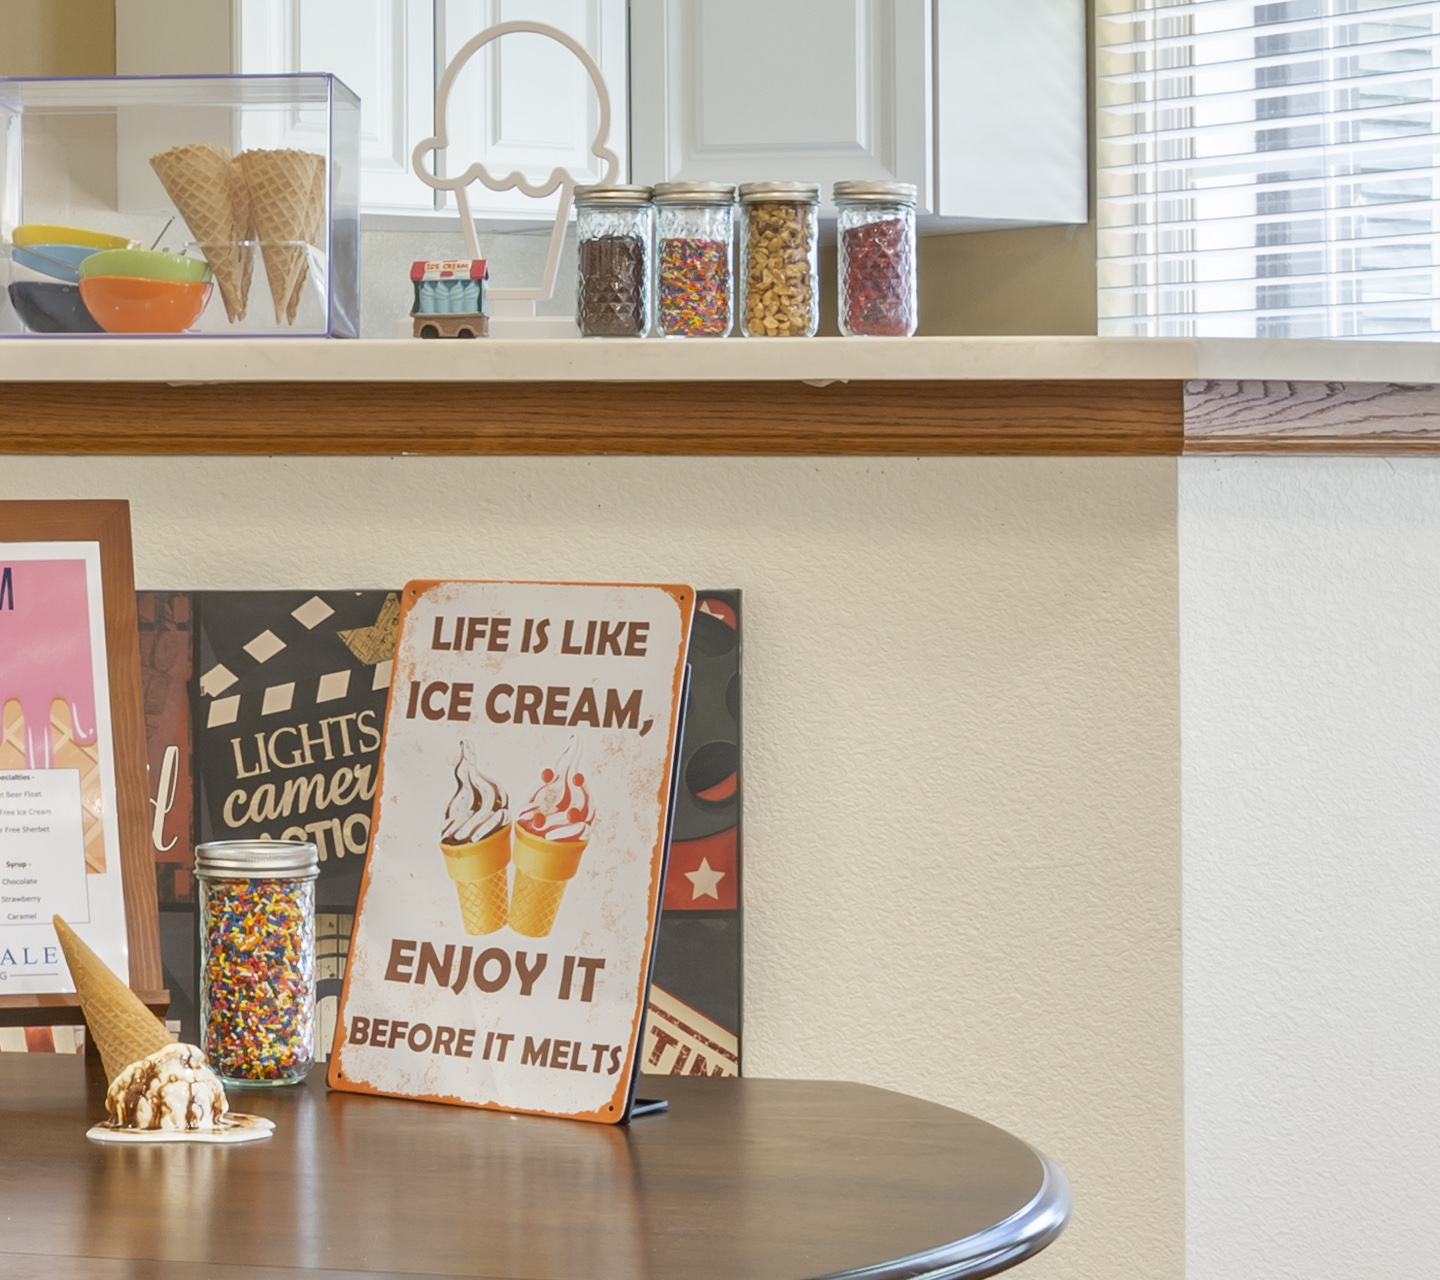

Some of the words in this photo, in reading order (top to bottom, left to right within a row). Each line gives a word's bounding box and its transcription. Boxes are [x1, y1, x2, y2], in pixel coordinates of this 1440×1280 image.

[432, 616, 511, 652] LIFE
[520, 618, 550, 654] IS
[561, 620, 650, 657] LIKE
[406, 681, 474, 721] ICE
[485, 683, 653, 737] CREAM,
[230, 709, 381, 780] LIGHTS
[6, 790, 22, 798] Beer
[24, 790, 42, 798] Float
[223, 763, 379, 828] camer
[0, 808, 15, 816] Free
[29, 807, 52, 815] Cream
[6, 860, 27, 869] Syrup
[2, 877, 37, 885] Chocolate
[1, 895, 41, 903] Strawberry
[7, 912, 37, 920] Caramel
[384, 938, 548, 996] ENJOY
[557, 955, 606, 1002] IT
[348, 1015, 476, 1058] BEFORE
[482, 1031, 515, 1062] IT
[520, 1035, 622, 1076] MELTS
